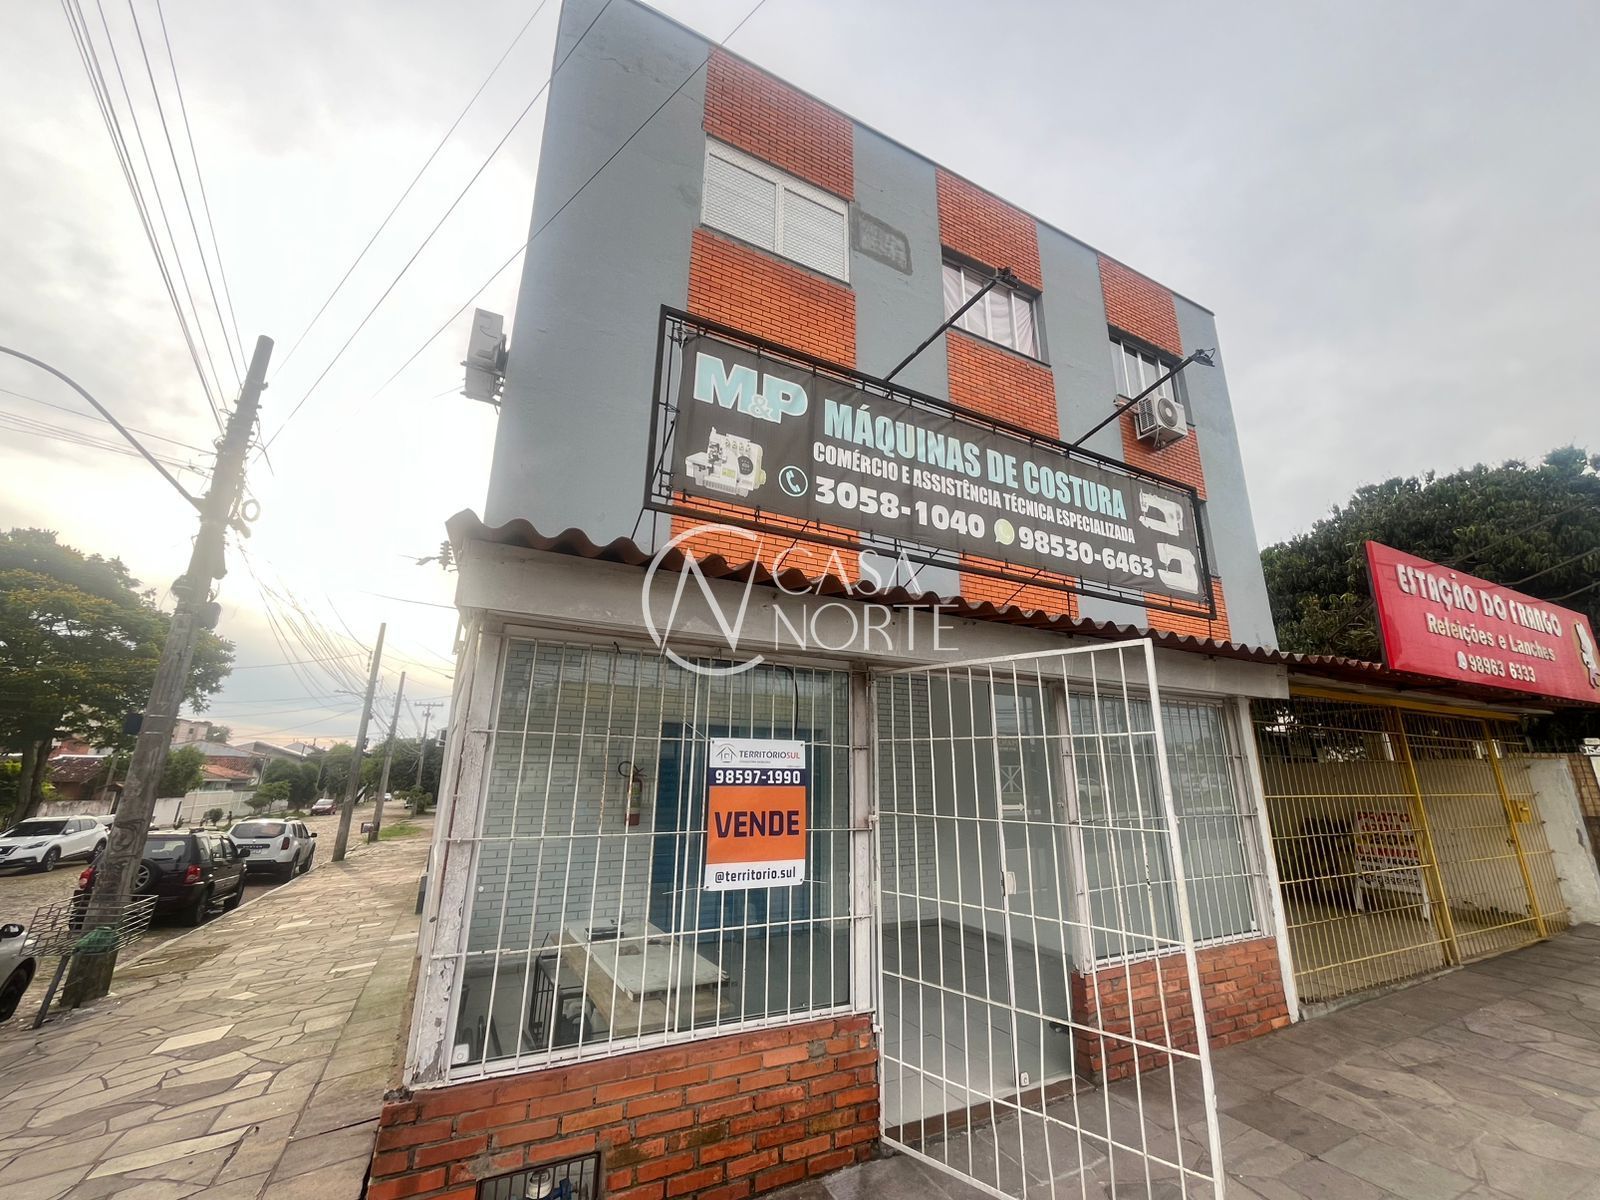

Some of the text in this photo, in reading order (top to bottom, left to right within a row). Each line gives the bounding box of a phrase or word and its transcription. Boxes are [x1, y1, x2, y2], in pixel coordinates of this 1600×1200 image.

[693, 351, 809, 424] M&P
[824, 398, 1127, 520] MÁQUINAS DE COSTURA
[813, 441, 1136, 544] COMÉRCIO E ASSISTÊNCIA TÉCNICA ESPECIALIZADA
[815, 475, 1155, 579] 3058-1040 98530-6463
[1396, 563, 1563, 637] ESTAÇÃO DO FRANGO
[1424, 612, 1556, 662] Refeições e Lanches
[1468, 654, 1536, 683] 98963 6333
[715, 769, 801, 784] 98597-1990
[714, 810, 800, 838] VENDE
[714, 866, 796, 884] @territorio.sul
